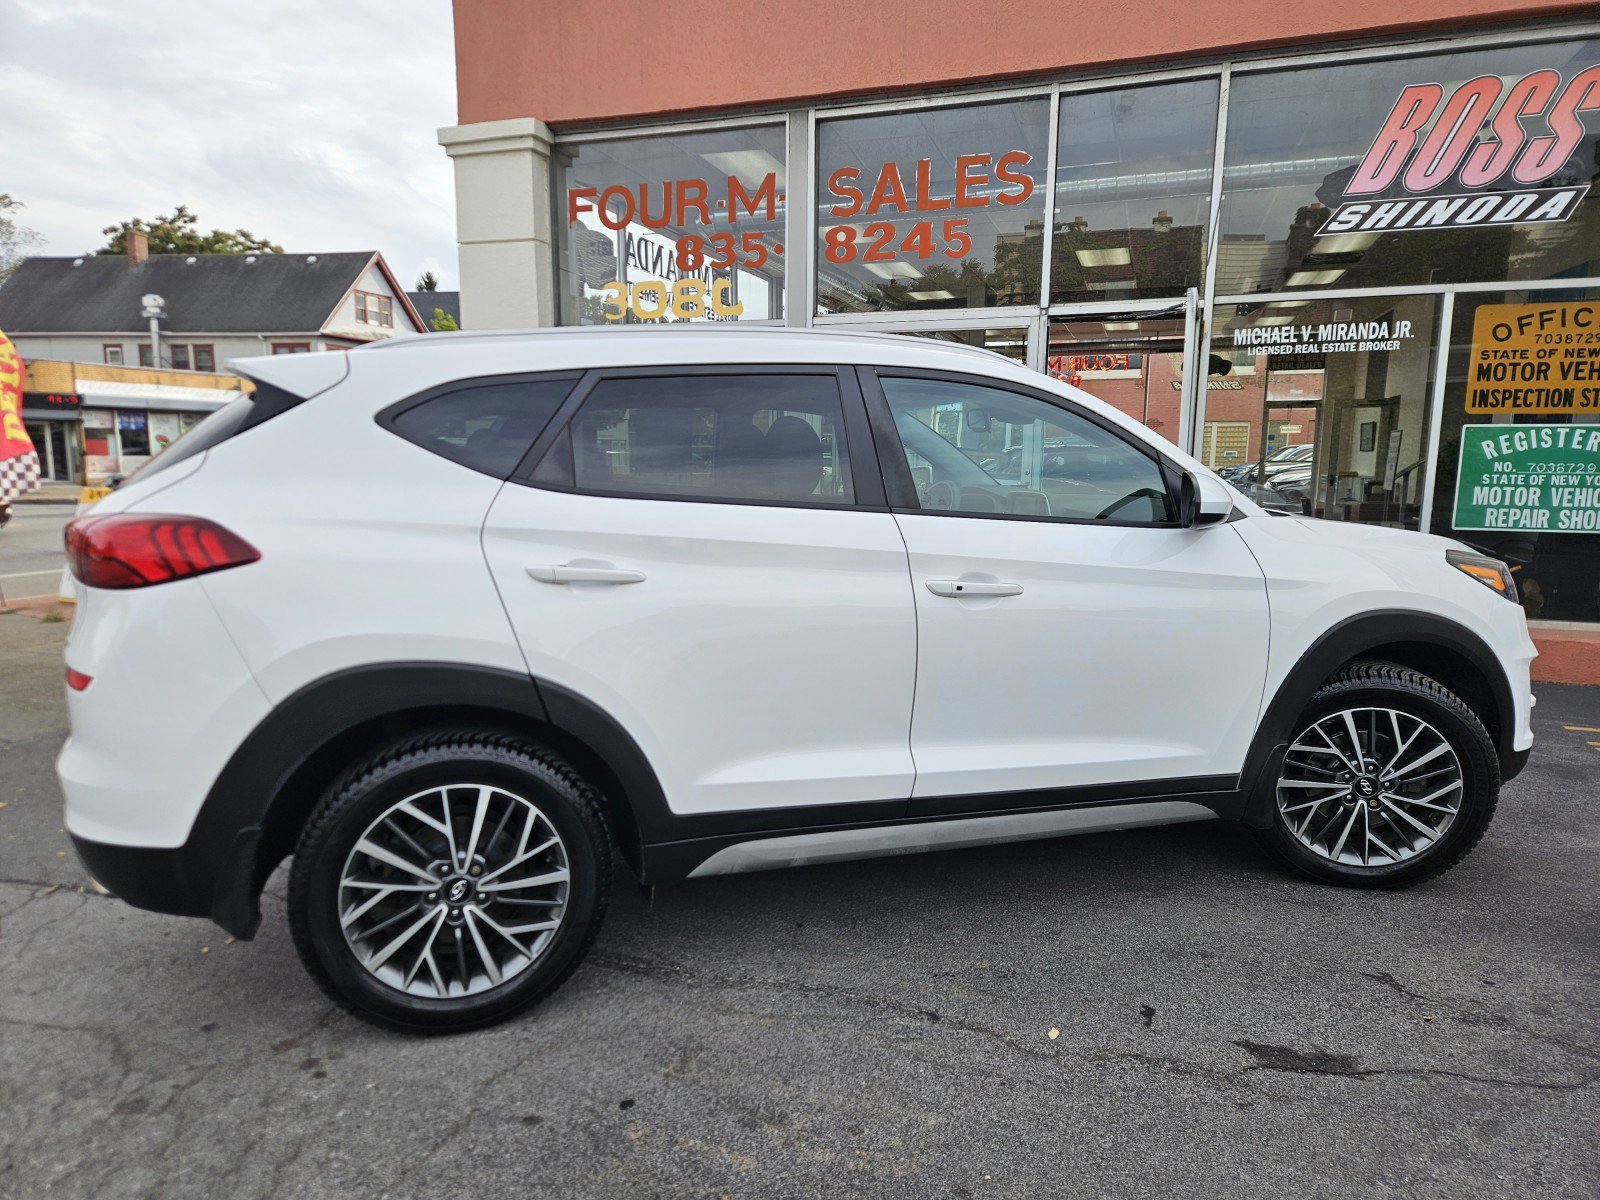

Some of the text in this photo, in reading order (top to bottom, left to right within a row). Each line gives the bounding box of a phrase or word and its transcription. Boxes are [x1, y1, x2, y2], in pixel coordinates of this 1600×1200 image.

[1342, 64, 1600, 196] BOSS
[827, 150, 1035, 217] SALES
[1326, 190, 1577, 231] SHINODA
[824, 217, 972, 264] 8245
[1233, 320, 1415, 346] MICHAEL V. MIRANDA JR.
[1492, 307, 1600, 342] OFFIC
[1247, 340, 1400, 356] LICENSED REAL ESTATE BROKER
[1481, 348, 1600, 360] STATE OF NEW
[1477, 361, 1600, 382] MOTOR VEH
[1471, 388, 1575, 408] INSPECTION
[1481, 428, 1600, 460] REGISTER
[1494, 462, 1597, 473] NO. 7038729
[1482, 474, 1525, 485] STATE
[1530, 475, 1546, 485] OF
[1551, 475, 1581, 486] NEW
[1472, 486, 1541, 506] MOTOR
[1484, 508, 1550, 528] REPAIR
